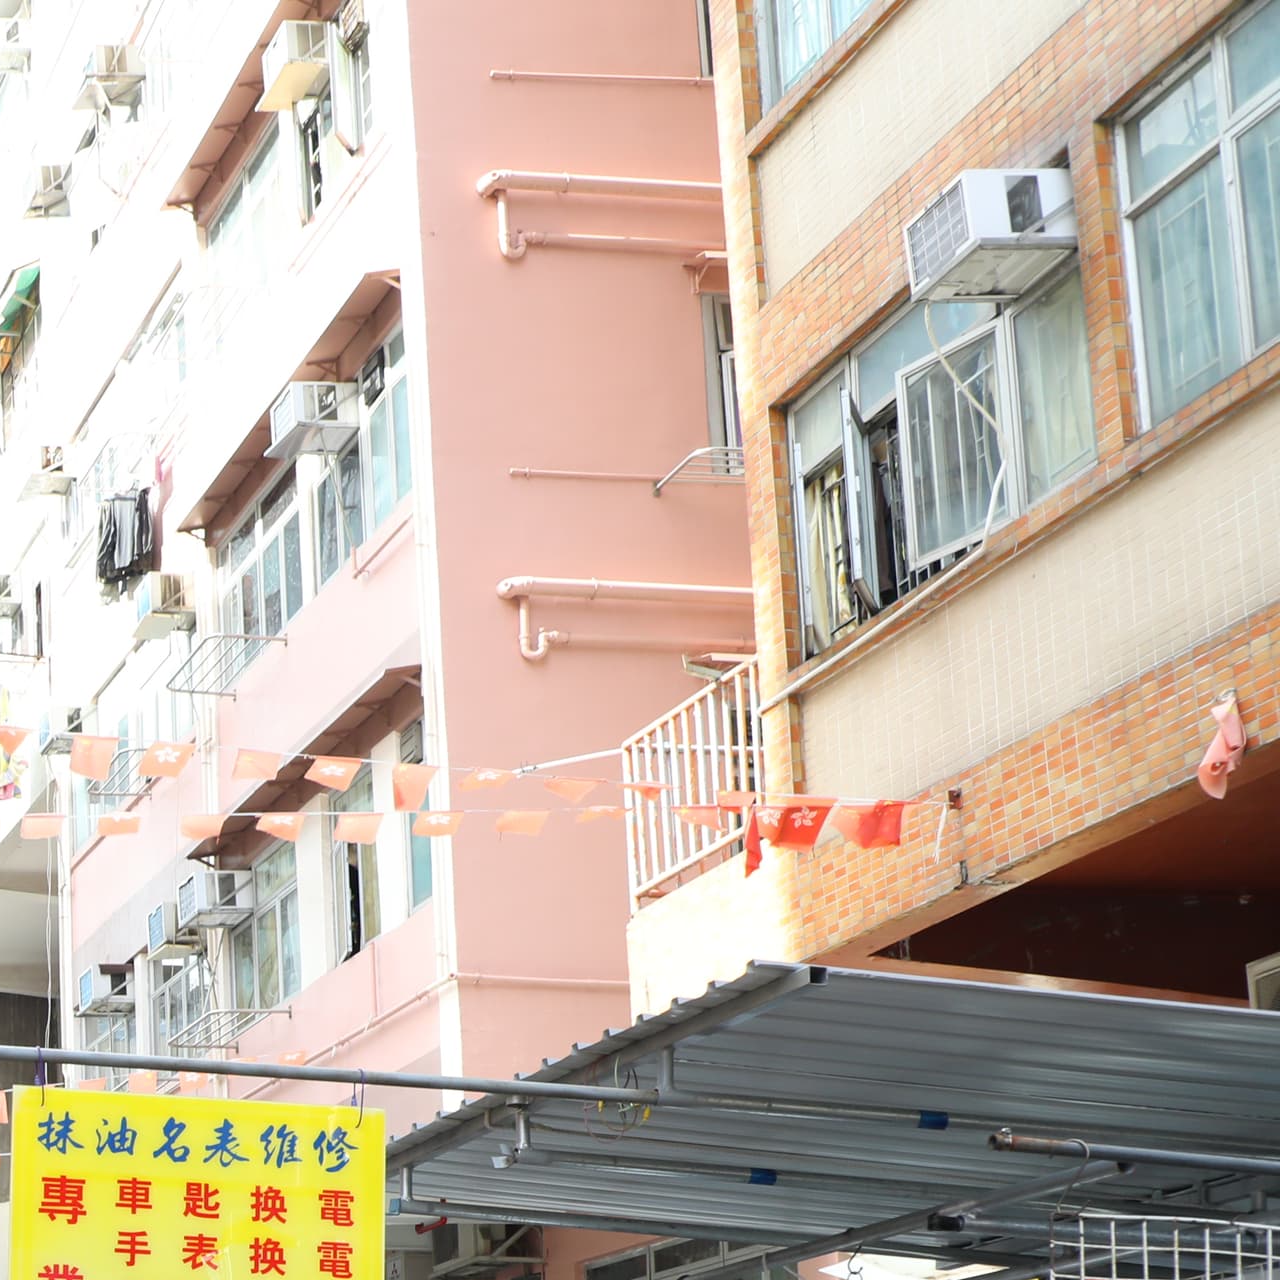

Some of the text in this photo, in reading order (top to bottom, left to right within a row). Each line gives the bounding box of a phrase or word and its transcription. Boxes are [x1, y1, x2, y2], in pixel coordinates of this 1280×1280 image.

[37, 1110, 360, 1173] 抹油名表維修
[114, 1177, 355, 1228] 車匙換電
[113, 1231, 354, 1280] 手表換電
